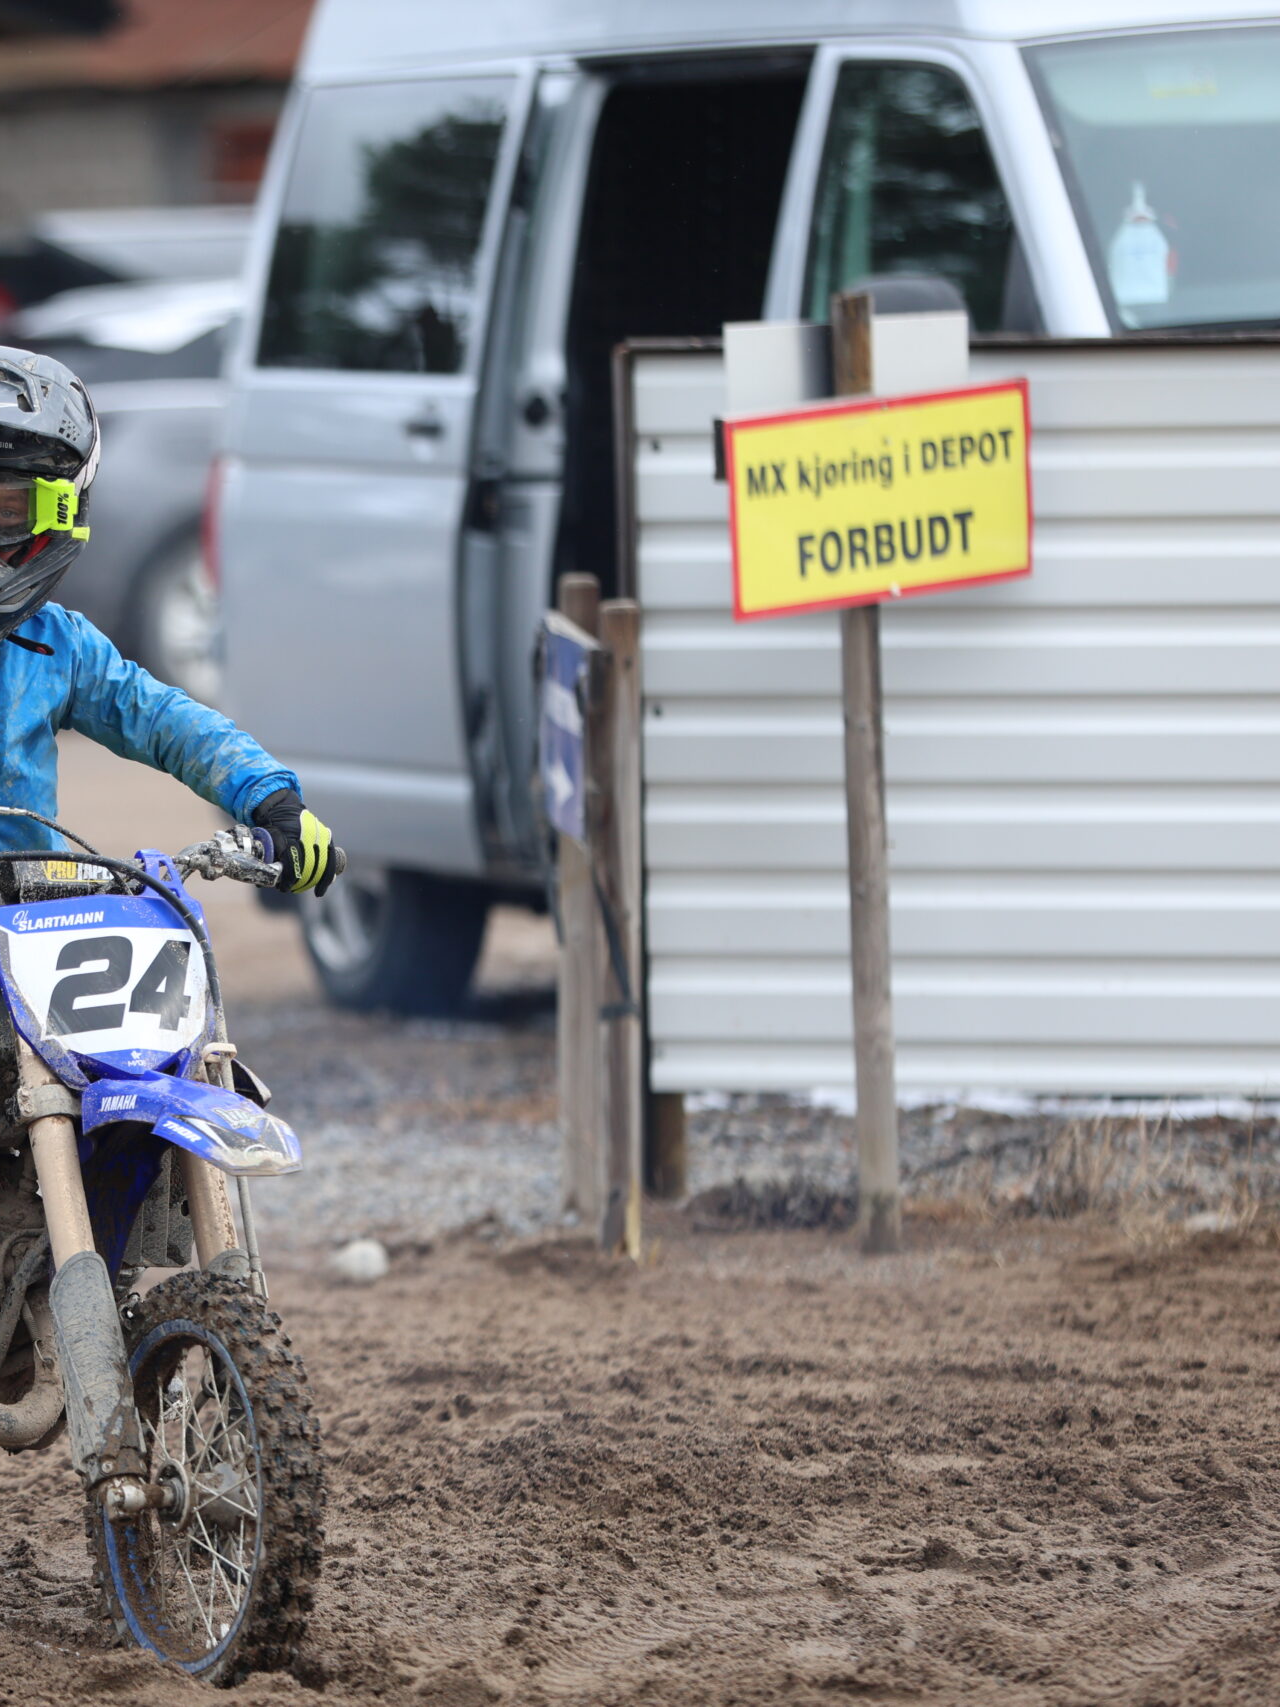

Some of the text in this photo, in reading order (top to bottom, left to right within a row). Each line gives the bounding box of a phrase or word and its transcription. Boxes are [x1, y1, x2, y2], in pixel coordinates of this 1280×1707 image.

[746, 460, 787, 498] MX
[903, 444, 912, 476] i
[920, 429, 1015, 472] DEPOT
[57, 493, 69, 525] 100%
[797, 509, 975, 582] FORBUDT
[18, 911, 105, 932] SLARTMANN
[45, 935, 192, 1037] 24
[100, 1094, 138, 1112] YAMAHA
[162, 1120, 202, 1142] THOR
